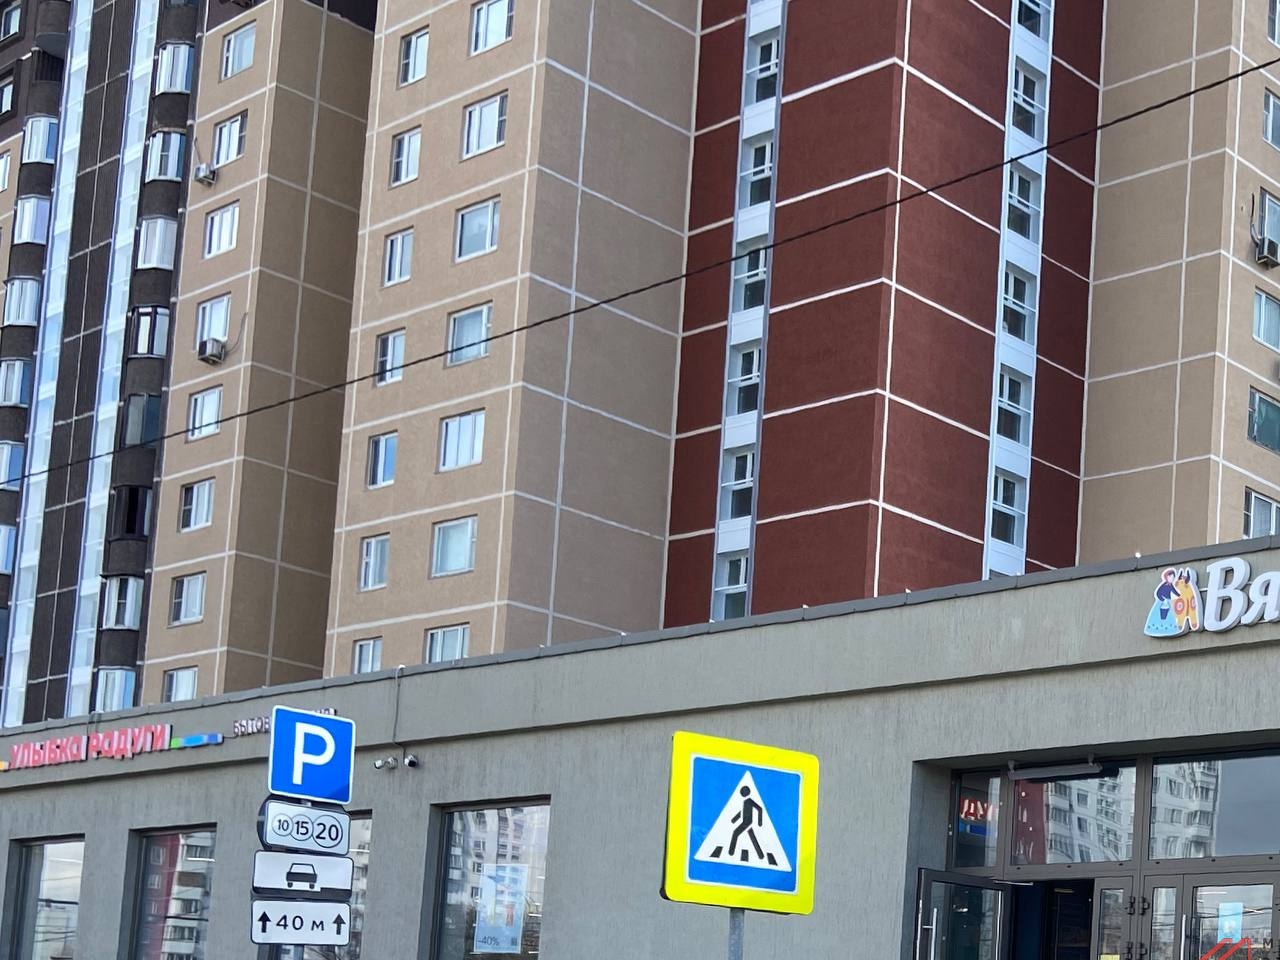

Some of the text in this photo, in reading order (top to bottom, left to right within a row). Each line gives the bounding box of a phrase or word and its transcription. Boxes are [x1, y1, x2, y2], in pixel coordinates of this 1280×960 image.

[292, 721, 336, 785] P
[277, 818, 340, 841] 10 15 20
[275, 914, 304, 931] 40
